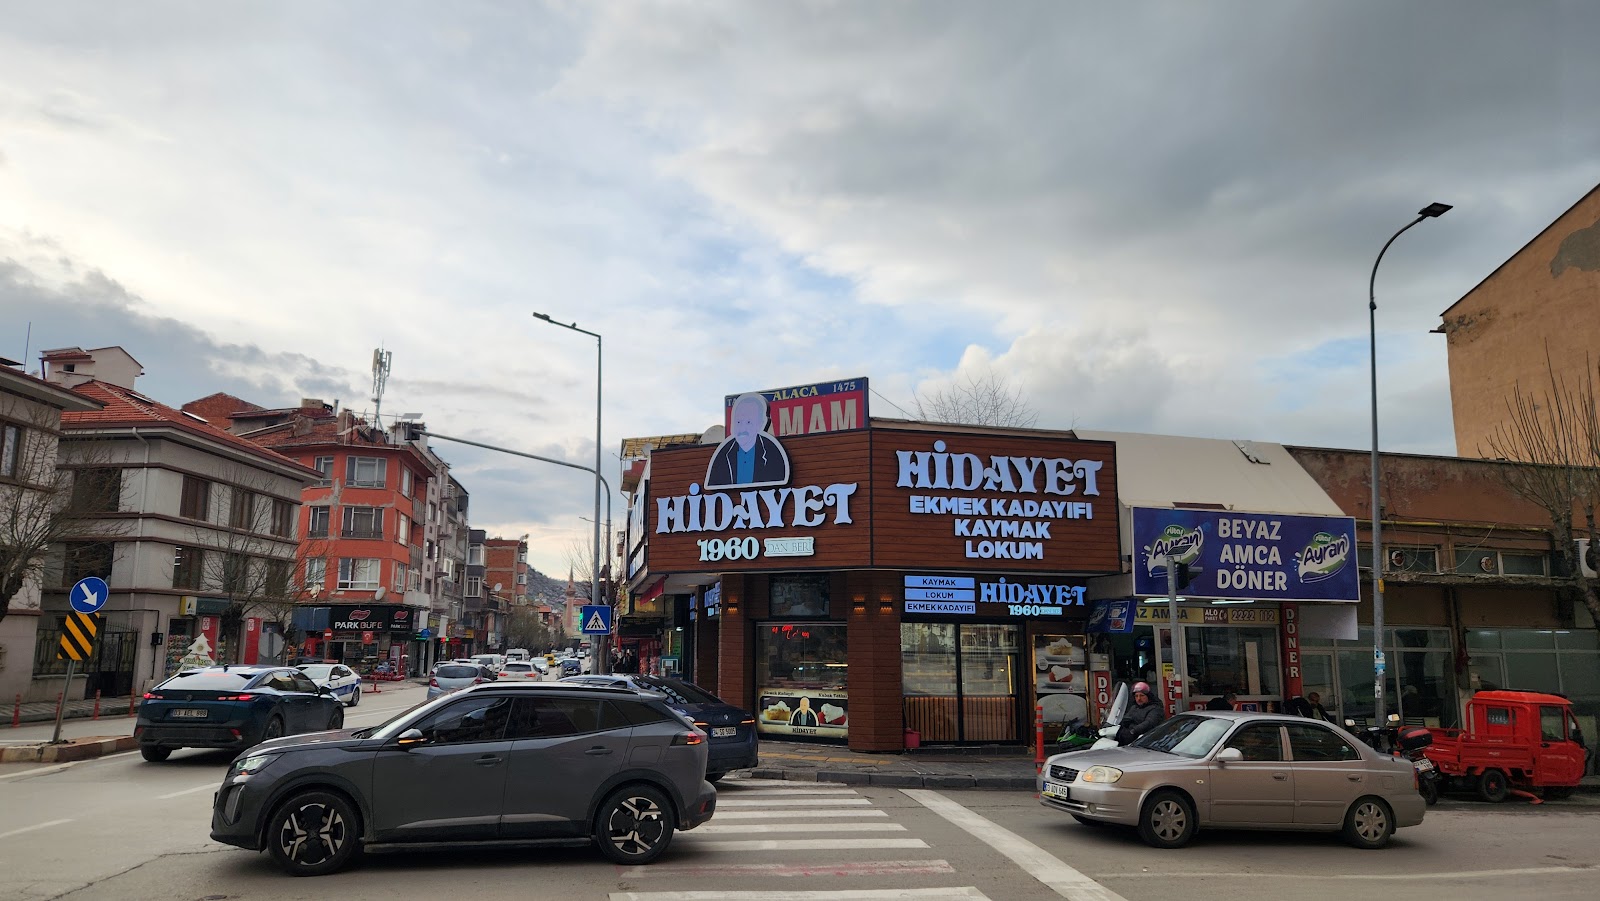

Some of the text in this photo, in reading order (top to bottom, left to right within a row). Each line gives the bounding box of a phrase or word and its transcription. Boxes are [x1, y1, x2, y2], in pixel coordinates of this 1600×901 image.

[772, 382, 856, 402] ALACA 1475
[770, 398, 857, 436] MAM
[895, 440, 1103, 496] HİDAYET
[655, 482, 858, 534] HİDAYET
[909, 495, 1093, 520] EKMEK KADAYIFI
[954, 518, 1052, 539] KAYMAK
[1218, 518, 1282, 541] BEYAZ
[697, 536, 760, 562] 1960
[767, 543, 789, 554] DAN
[965, 540, 1044, 560] LOKUM
[1219, 543, 1282, 566] AMCA
[1303, 540, 1346, 566] Ayran
[922, 578, 956, 586] KAYMAK
[1216, 565, 1288, 591] DÖNER
[925, 591, 954, 599] LOKUM
[979, 576, 1087, 606] HİDAYET
[1008, 604, 1040, 617] 1960
[1232, 610, 1255, 621] 2222
[334, 621, 359, 629] PARK
[1285, 608, 1299, 678] DÖNER
[792, 726, 817, 735] HİDAYET
